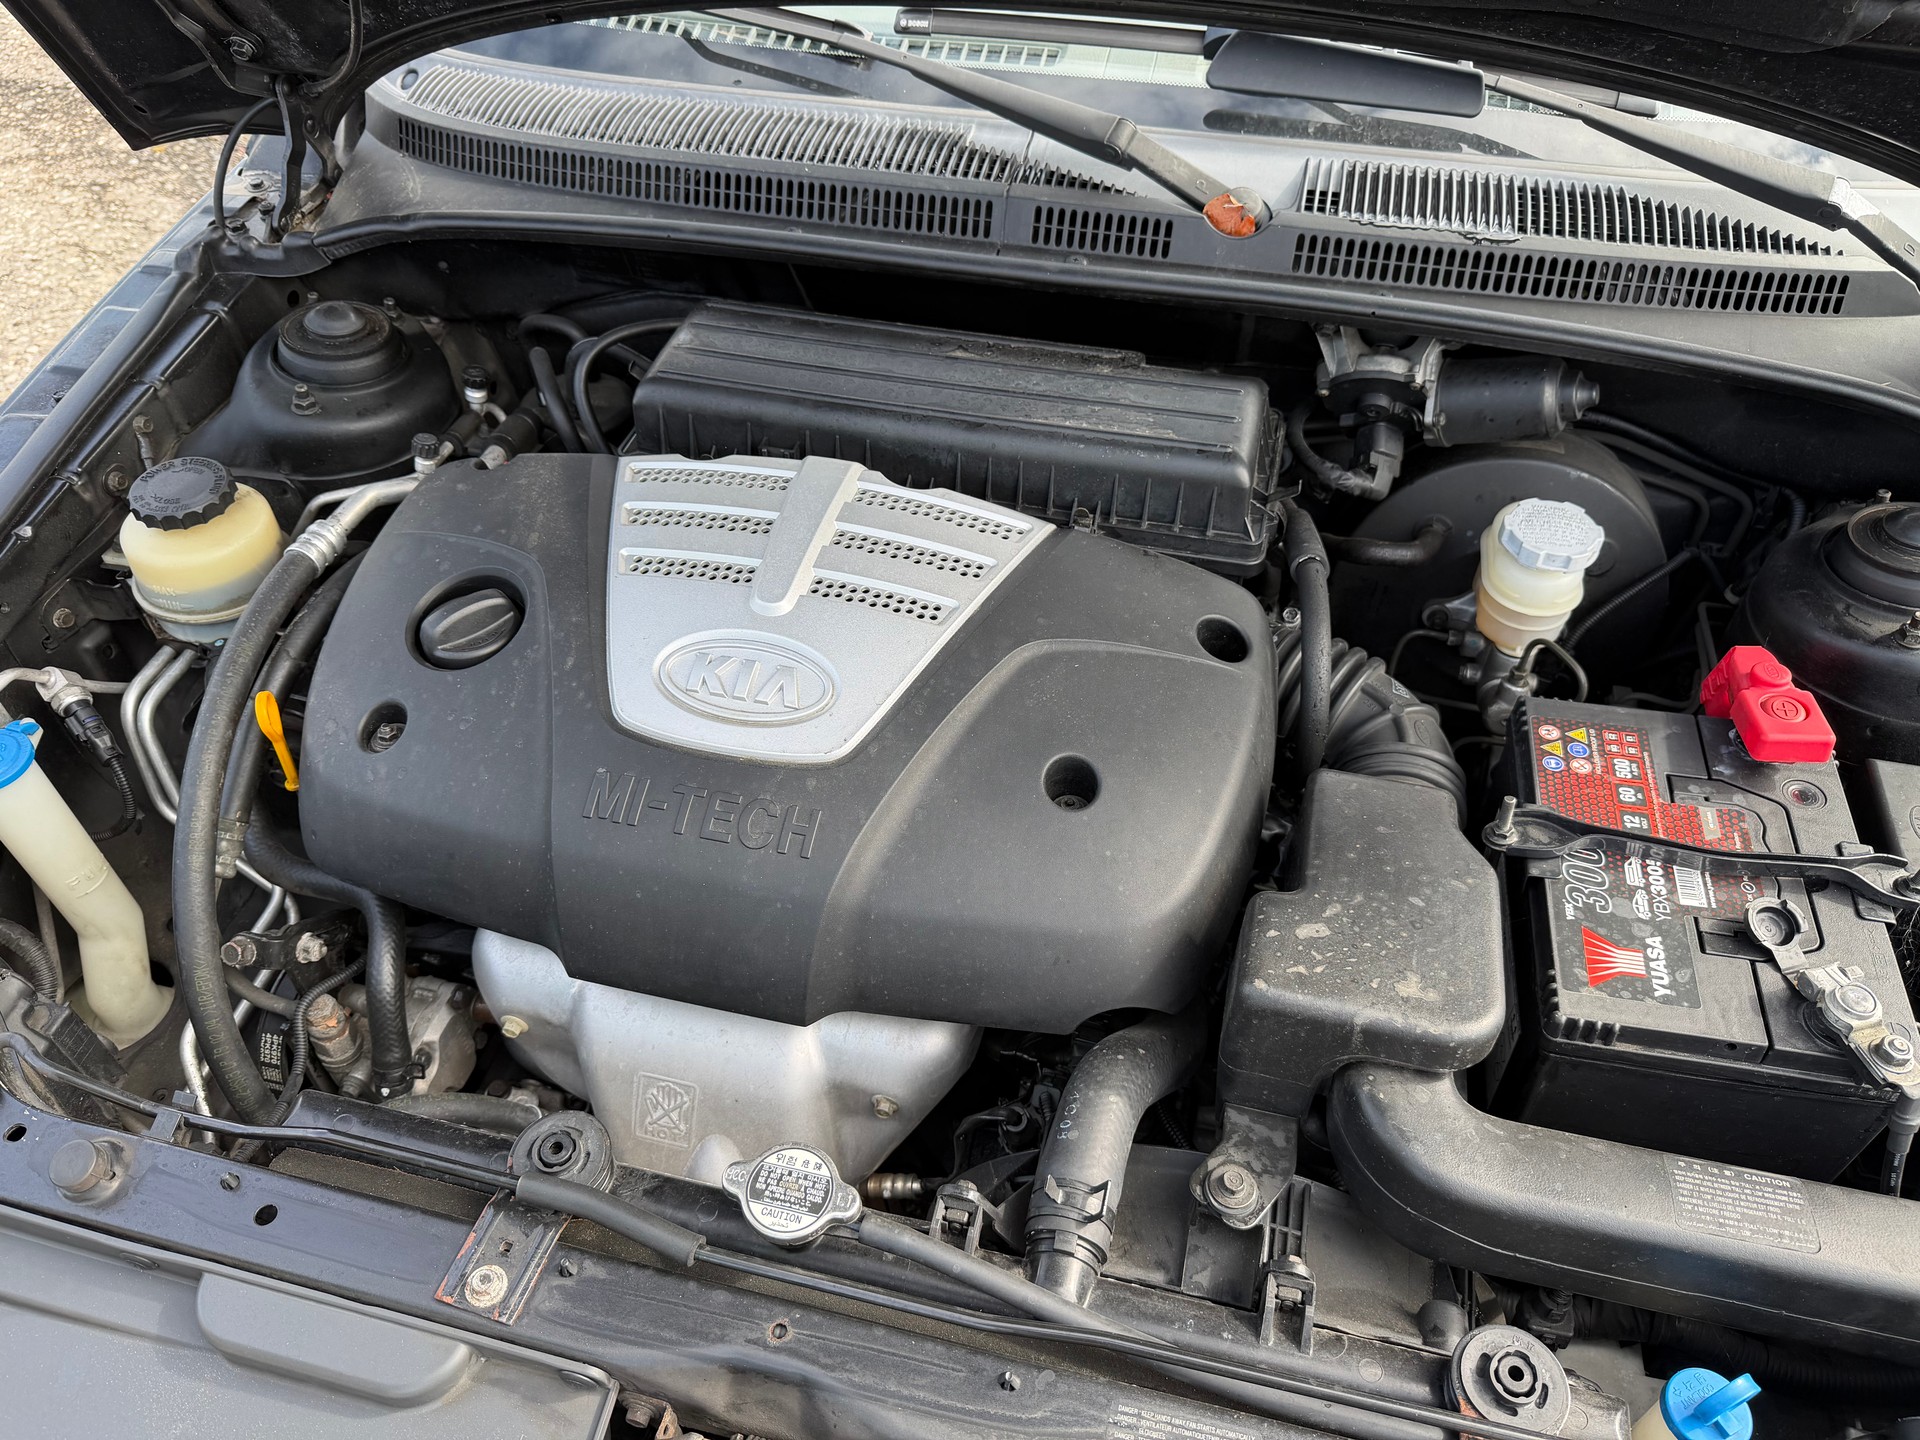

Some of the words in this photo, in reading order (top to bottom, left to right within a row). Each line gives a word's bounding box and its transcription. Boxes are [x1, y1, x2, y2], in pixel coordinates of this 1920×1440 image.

[907, 20, 929, 28] BOSCH
[140, 461, 176, 482] POWER
[686, 653, 801, 710] KIA
[1613, 758, 1632, 779] 500
[1618, 787, 1636, 802] 60
[582, 769, 822, 860] MI-TECH
[1623, 815, 1641, 829] 12
[1641, 817, 1649, 830] VOLT
[1645, 936, 1671, 998] YUASA
[271, 1034, 279, 1065] 4PK970
[775, 1152, 797, 1166] 위험
[760, 1169, 768, 1177] DO
[769, 1171, 781, 1179] NOT
[781, 1174, 796, 1183] OPEN
[766, 1177, 777, 1185] PAS
[1743, 1173, 1790, 1187] CAUTION
[760, 1206, 803, 1224] CAUTION
[1680, 1383, 1715, 1410] COOLANT
[1117, 1404, 1138, 1414] DANGER
[1140, 1410, 1154, 1418] KEEP
[1153, 1413, 1171, 1422] HANDS
[1115, 1413, 1136, 1423] DANGER
[1139, 1419, 1171, 1432] VENTILATEUR
